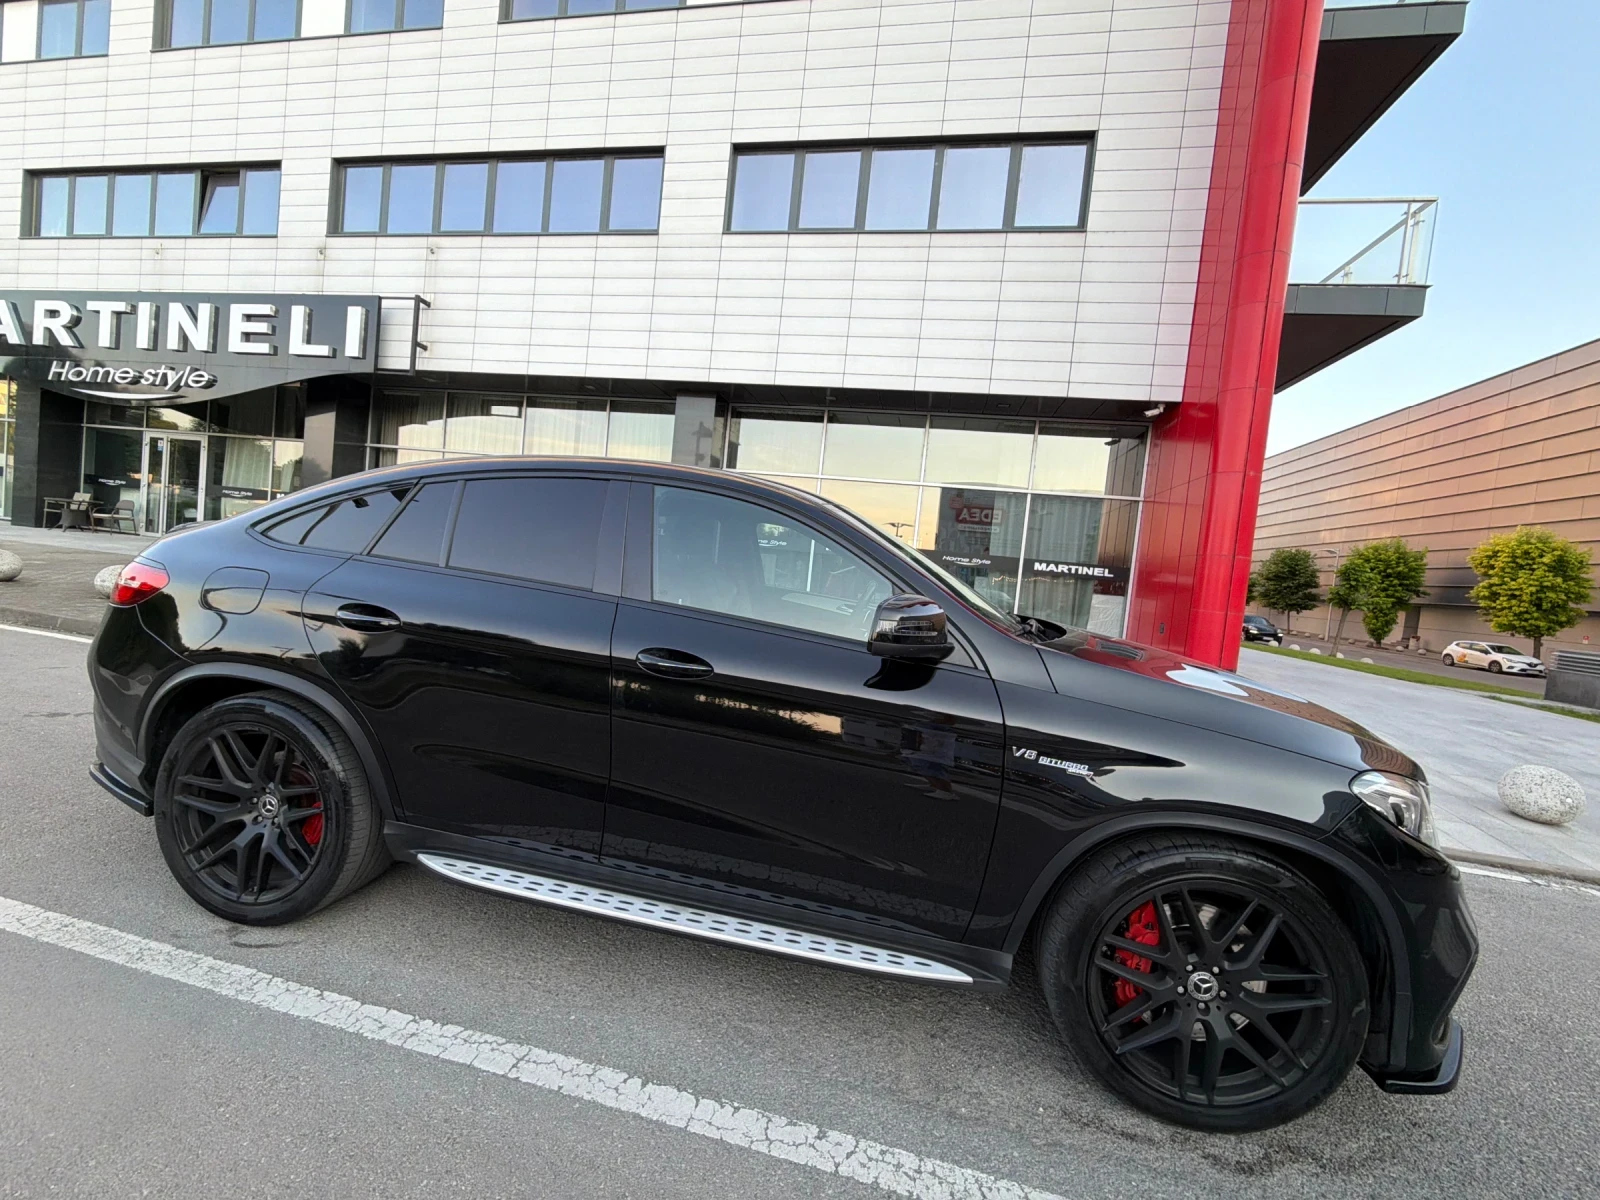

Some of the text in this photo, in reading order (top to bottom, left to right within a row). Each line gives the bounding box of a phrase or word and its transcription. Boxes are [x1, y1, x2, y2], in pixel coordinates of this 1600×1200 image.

[48, 360, 212, 392] Home style
[942, 555, 970, 563] Home
[1033, 561, 1114, 578] MARTINEL
[1012, 746, 1089, 772] V8 BITURBO
